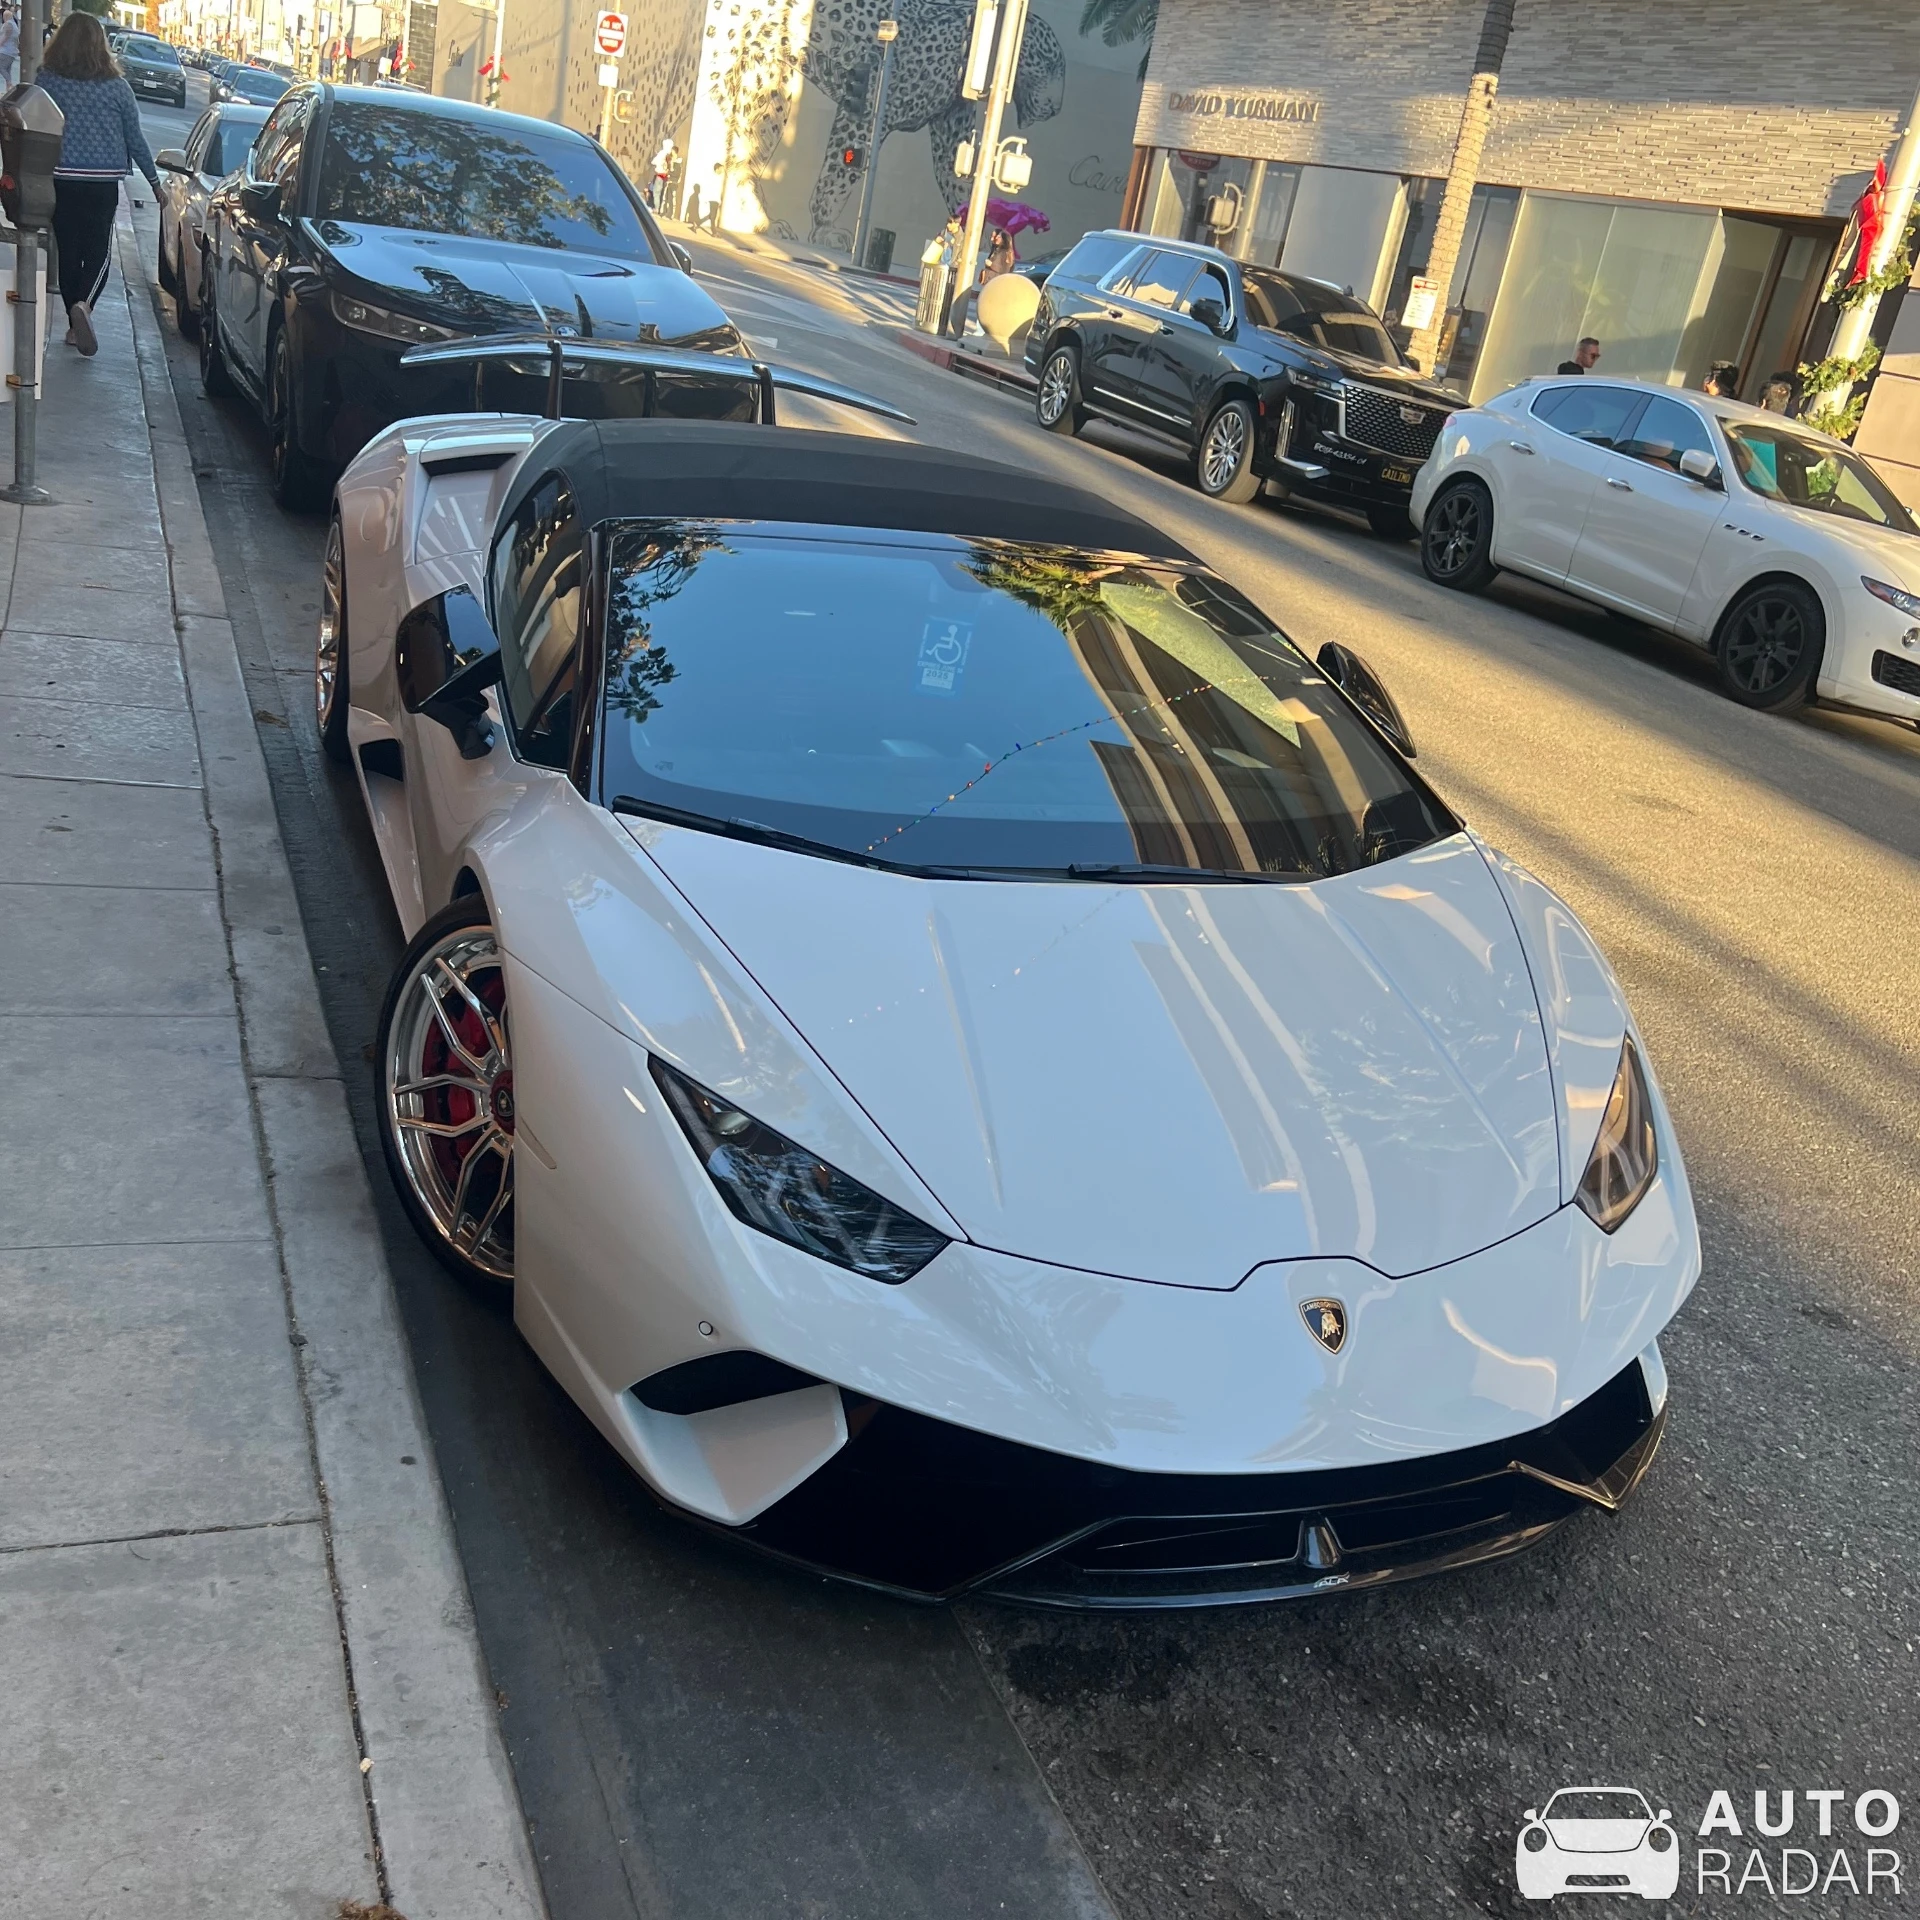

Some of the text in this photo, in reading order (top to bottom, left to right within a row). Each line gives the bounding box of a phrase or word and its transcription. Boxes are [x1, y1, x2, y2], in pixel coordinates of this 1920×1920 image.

[1168, 92, 1320, 122] DAVID YURMAN
[926, 669, 949, 680] 2025
